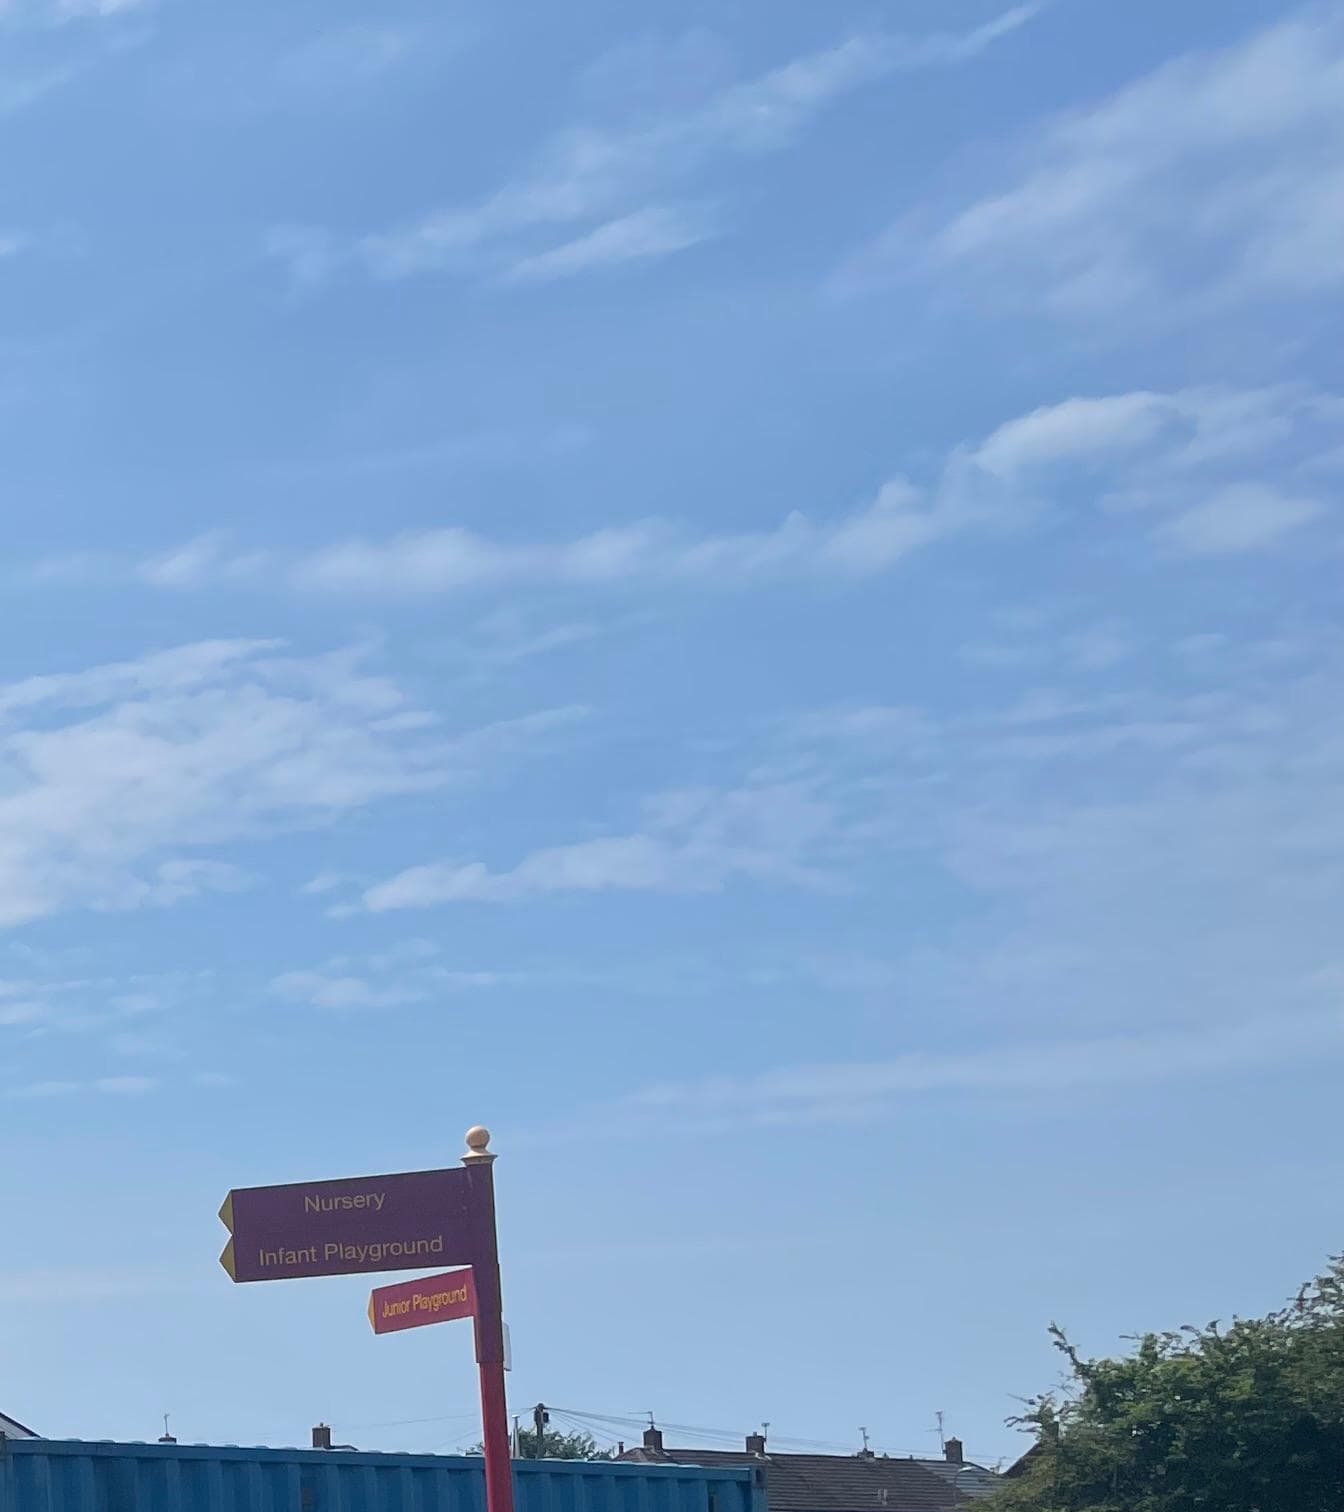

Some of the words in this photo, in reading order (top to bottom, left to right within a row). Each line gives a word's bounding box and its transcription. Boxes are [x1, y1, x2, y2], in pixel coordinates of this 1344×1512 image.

[304, 1192, 385, 1212] Nursery
[259, 1246, 317, 1266] Infant
[324, 1235, 443, 1263] Playground
[382, 1300, 410, 1318] Junior
[412, 1286, 467, 1312] Playground
